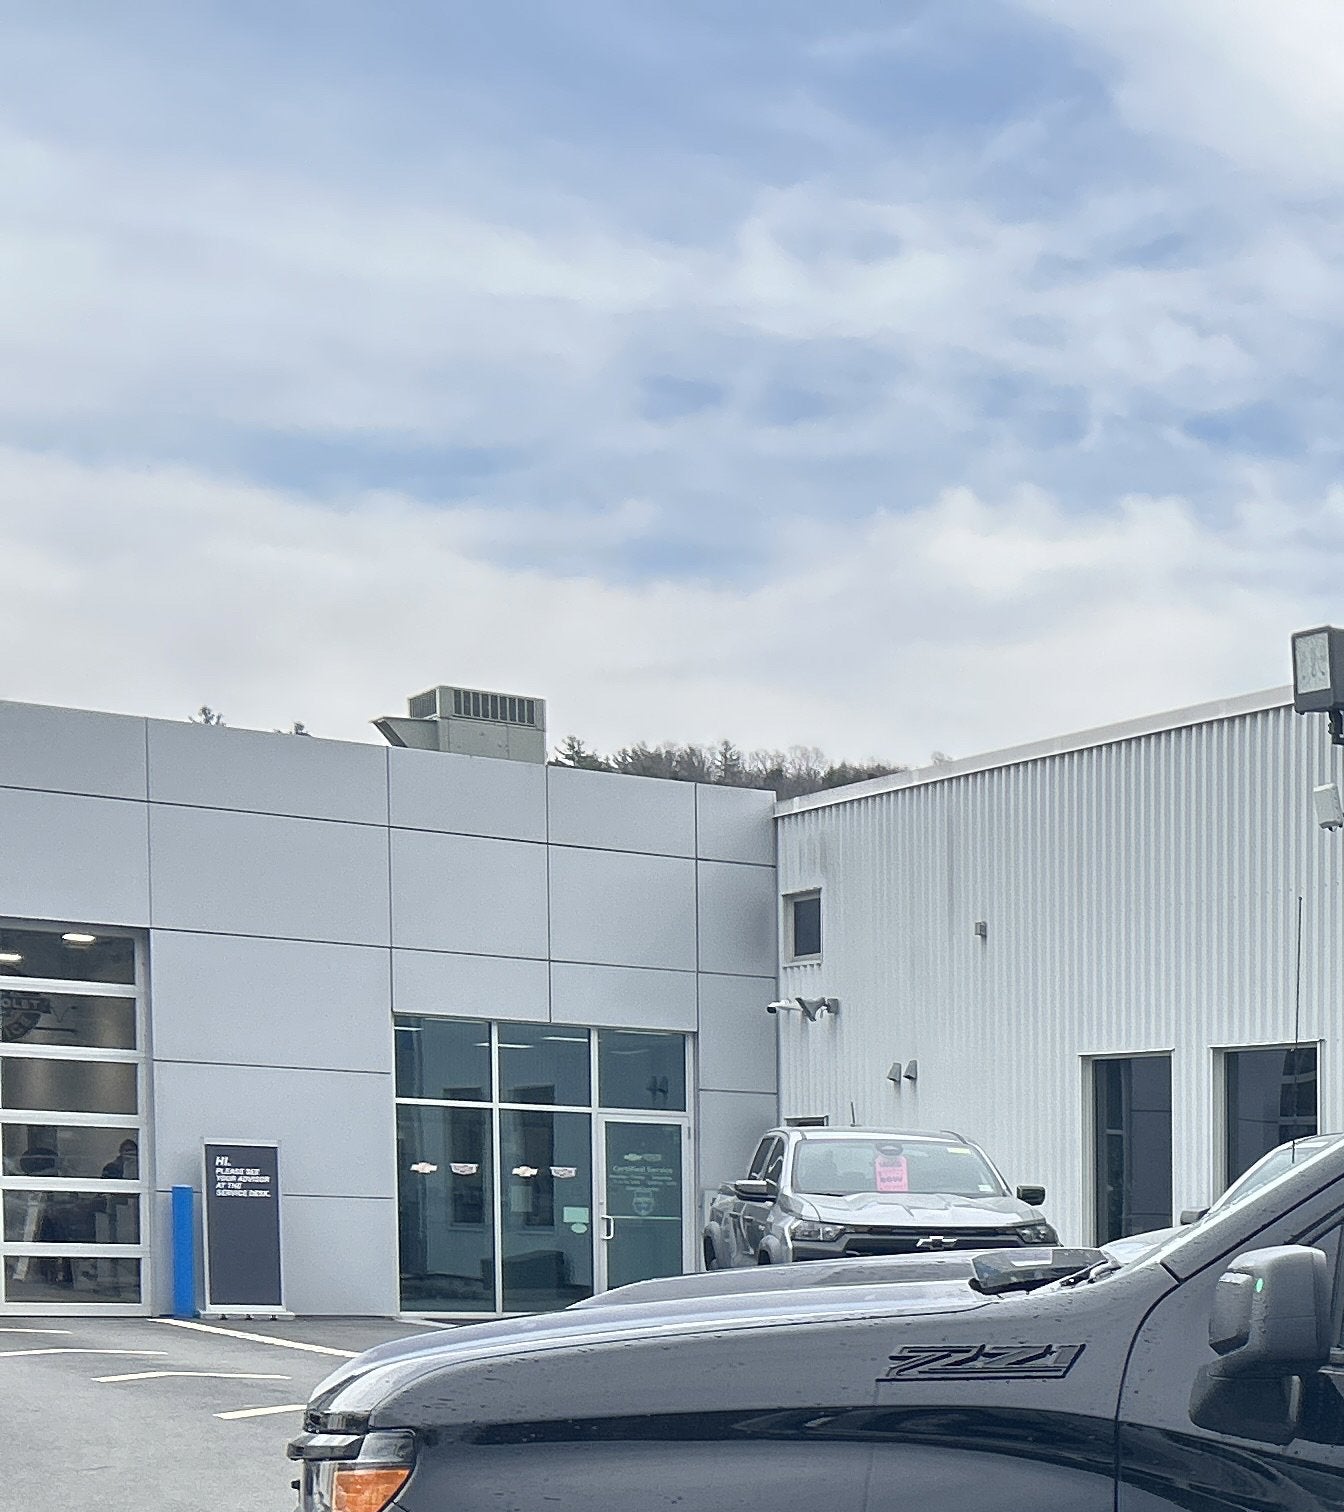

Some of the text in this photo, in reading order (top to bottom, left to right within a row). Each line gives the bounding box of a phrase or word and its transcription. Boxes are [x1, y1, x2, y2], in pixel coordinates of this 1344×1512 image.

[215, 1167, 244, 1175] PLEASE
[237, 1175, 271, 1183] ADVISOR
[215, 1189, 247, 1197] SERVICE
[876, 1343, 1087, 1383] Z71
